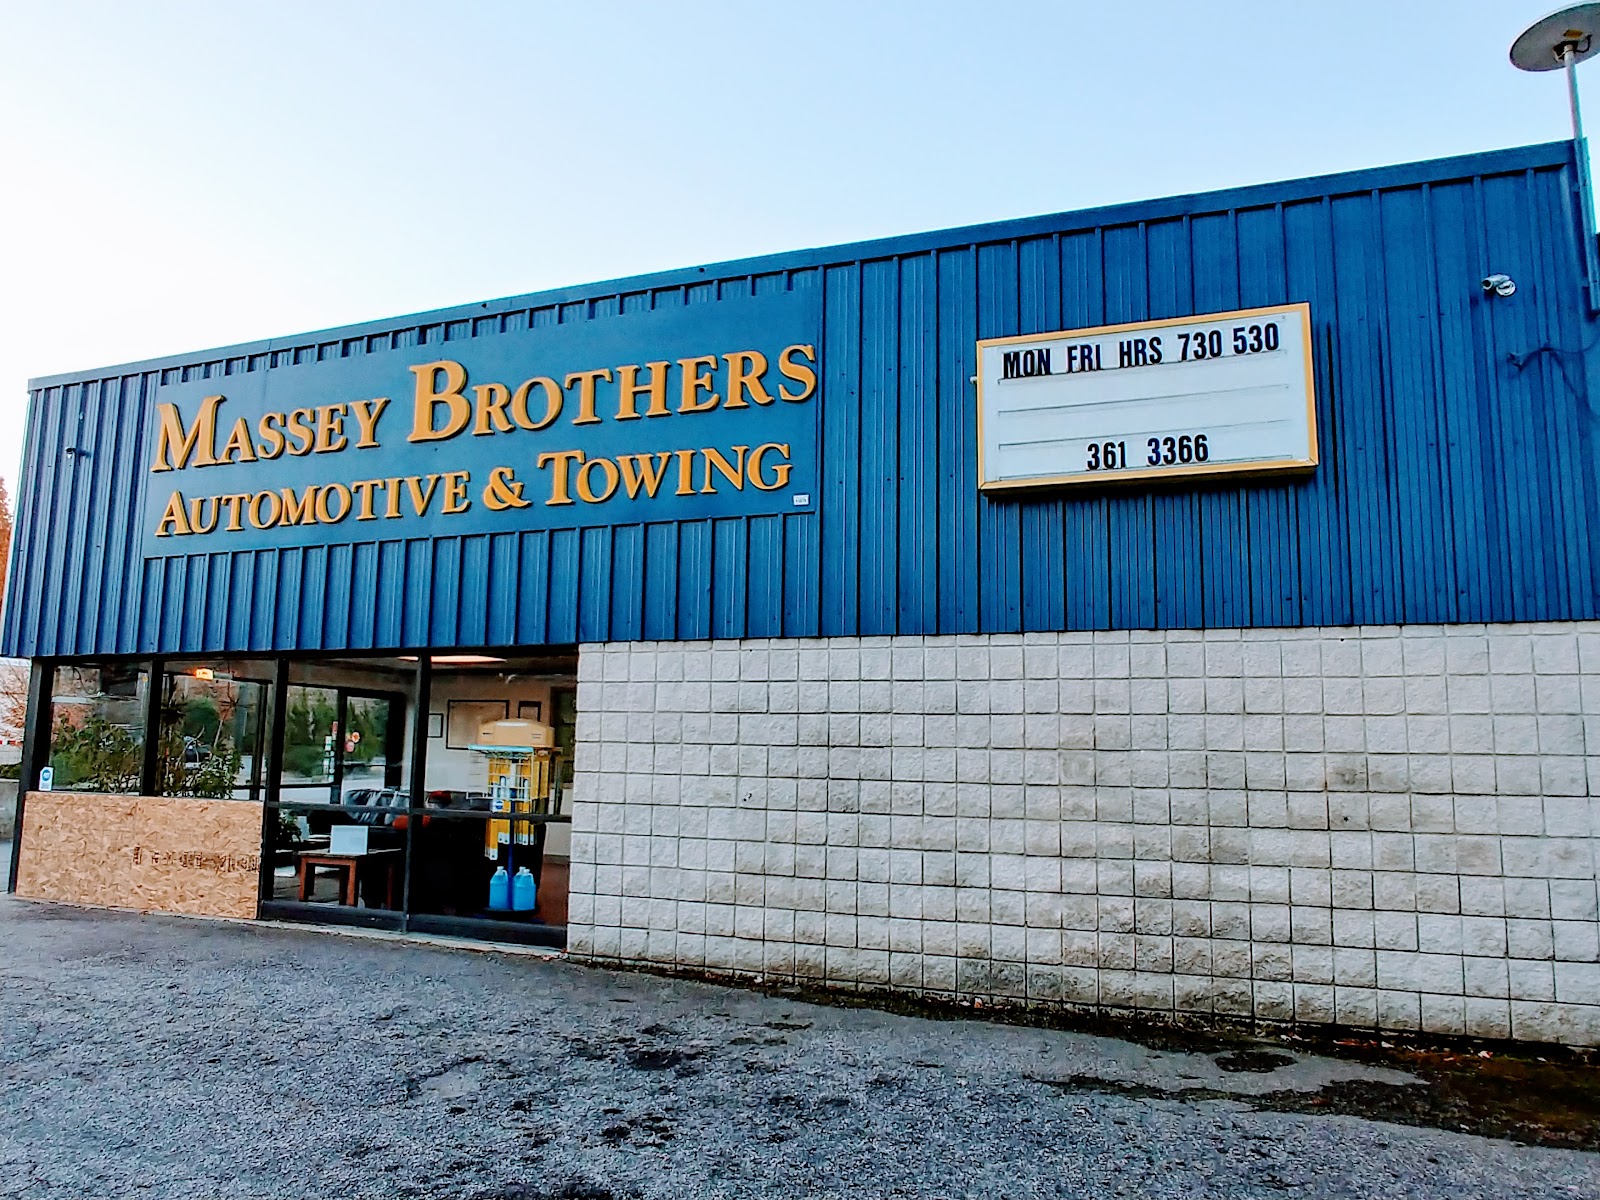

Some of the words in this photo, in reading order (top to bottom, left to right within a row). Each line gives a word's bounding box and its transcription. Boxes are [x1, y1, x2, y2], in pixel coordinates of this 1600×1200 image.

[1003, 349, 1051, 379] MON
[1066, 344, 1100, 374] FRI
[1119, 336, 1163, 369] HRS
[1178, 330, 1222, 363] 730
[1233, 322, 1279, 354] 530
[151, 395, 390, 472] MASSEY
[407, 344, 817, 443] BROTHERS
[155, 470, 471, 537] AUTOMOTIVE
[483, 466, 531, 511] &
[537, 443, 793, 506] TOWING
[1087, 441, 1126, 471] 361
[1147, 434, 1209, 466] 3366
